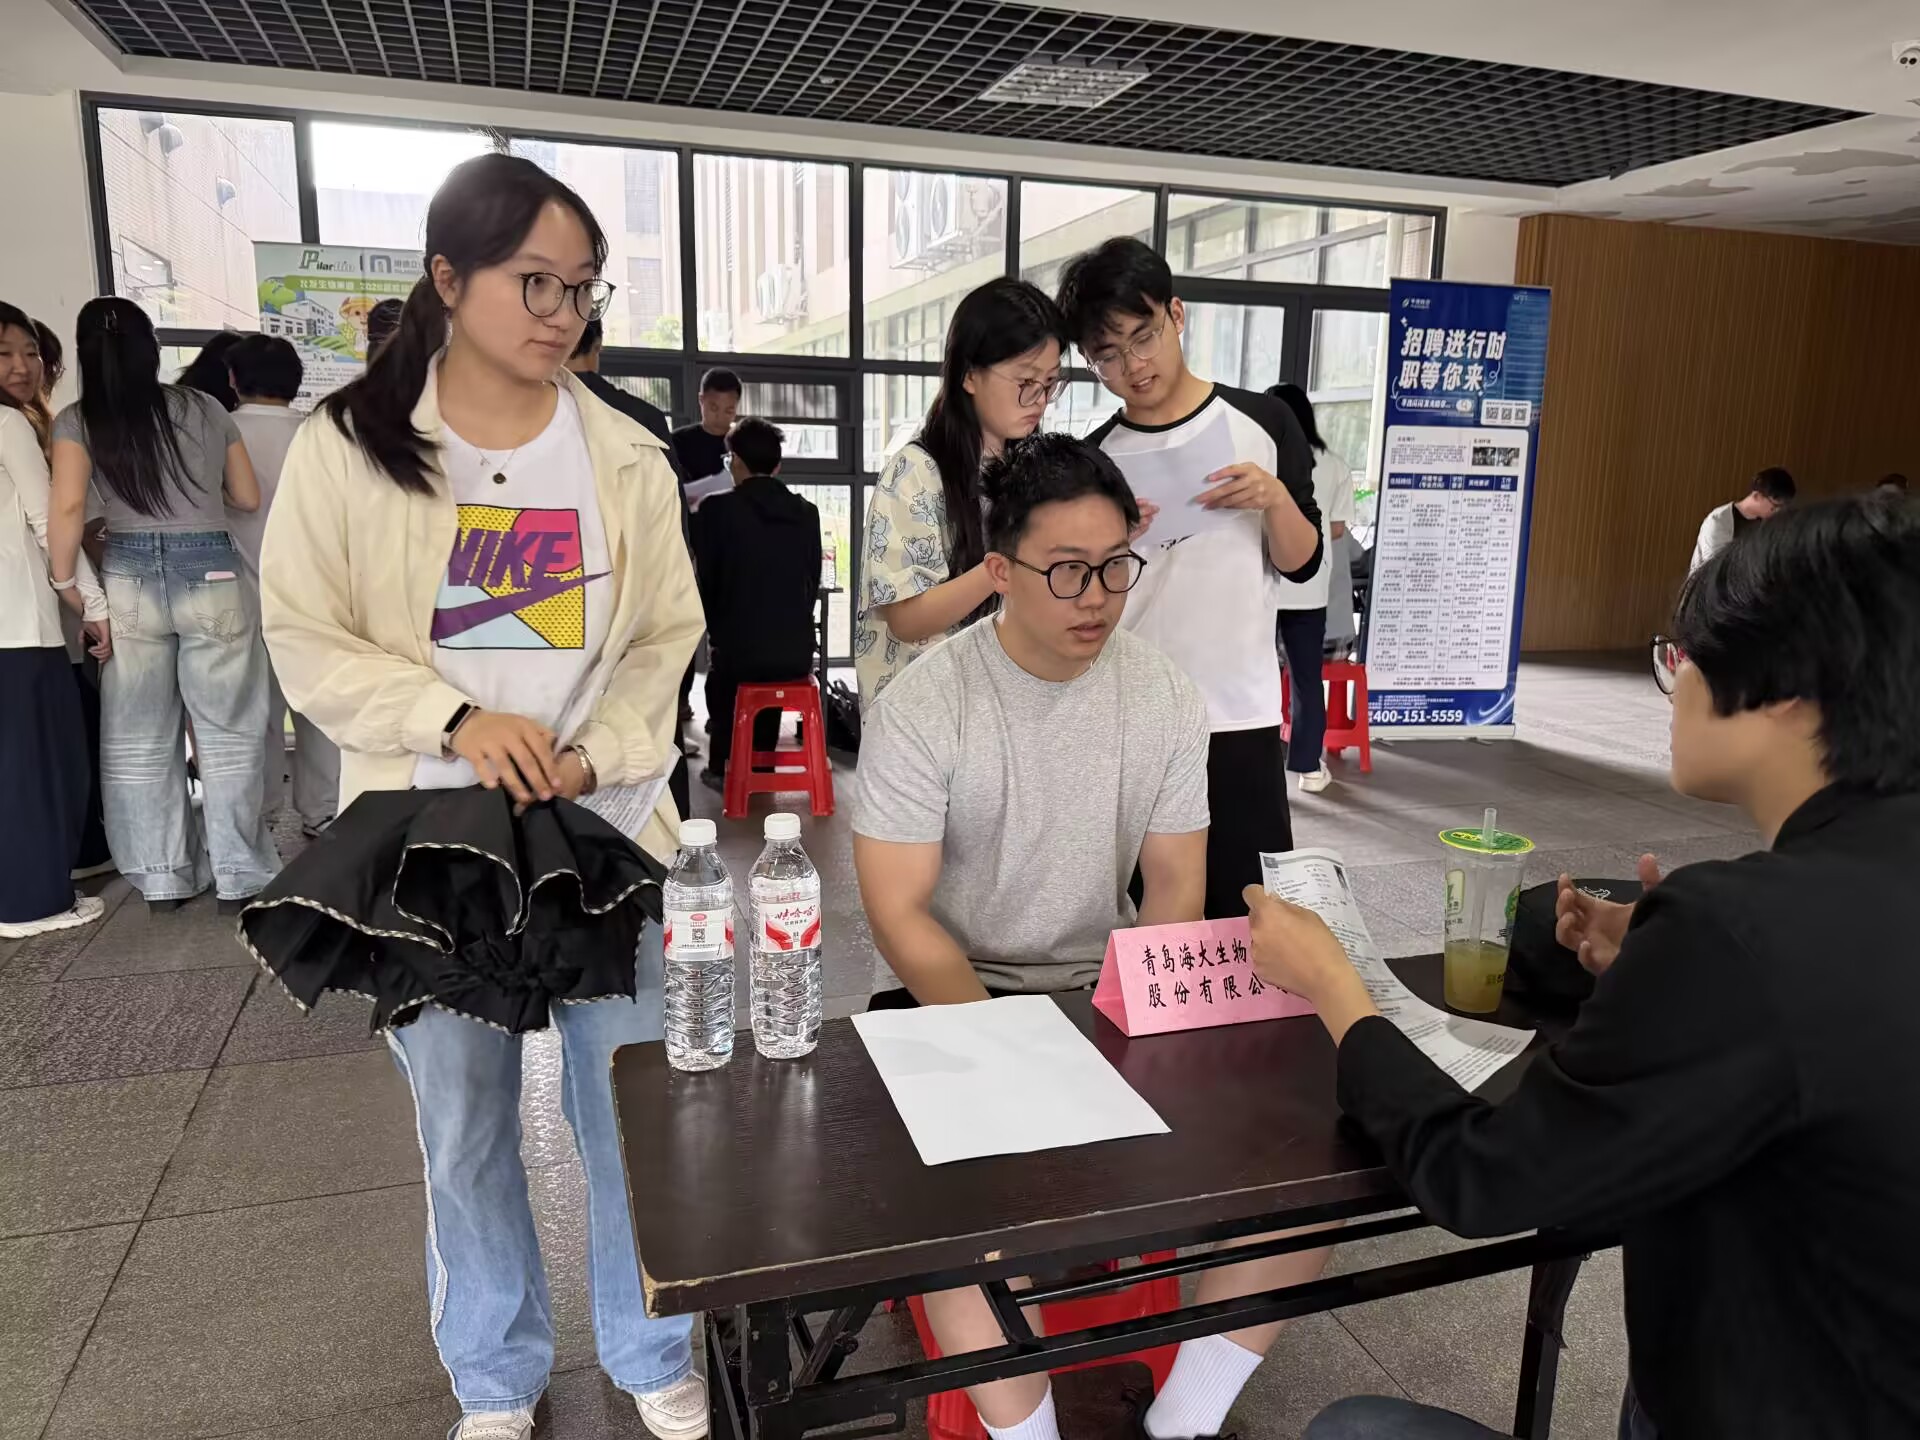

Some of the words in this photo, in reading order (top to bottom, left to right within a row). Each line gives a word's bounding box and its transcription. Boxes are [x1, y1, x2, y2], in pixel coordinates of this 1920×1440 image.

[1400, 326, 1507, 361] 招聘进行时
[1398, 360, 1485, 392] 职等你来
[1373, 709, 1463, 723] 400-151-5559
[1141, 937, 1248, 977] 青岛海大生物
[1148, 971, 1289, 1009] 股份有限公
